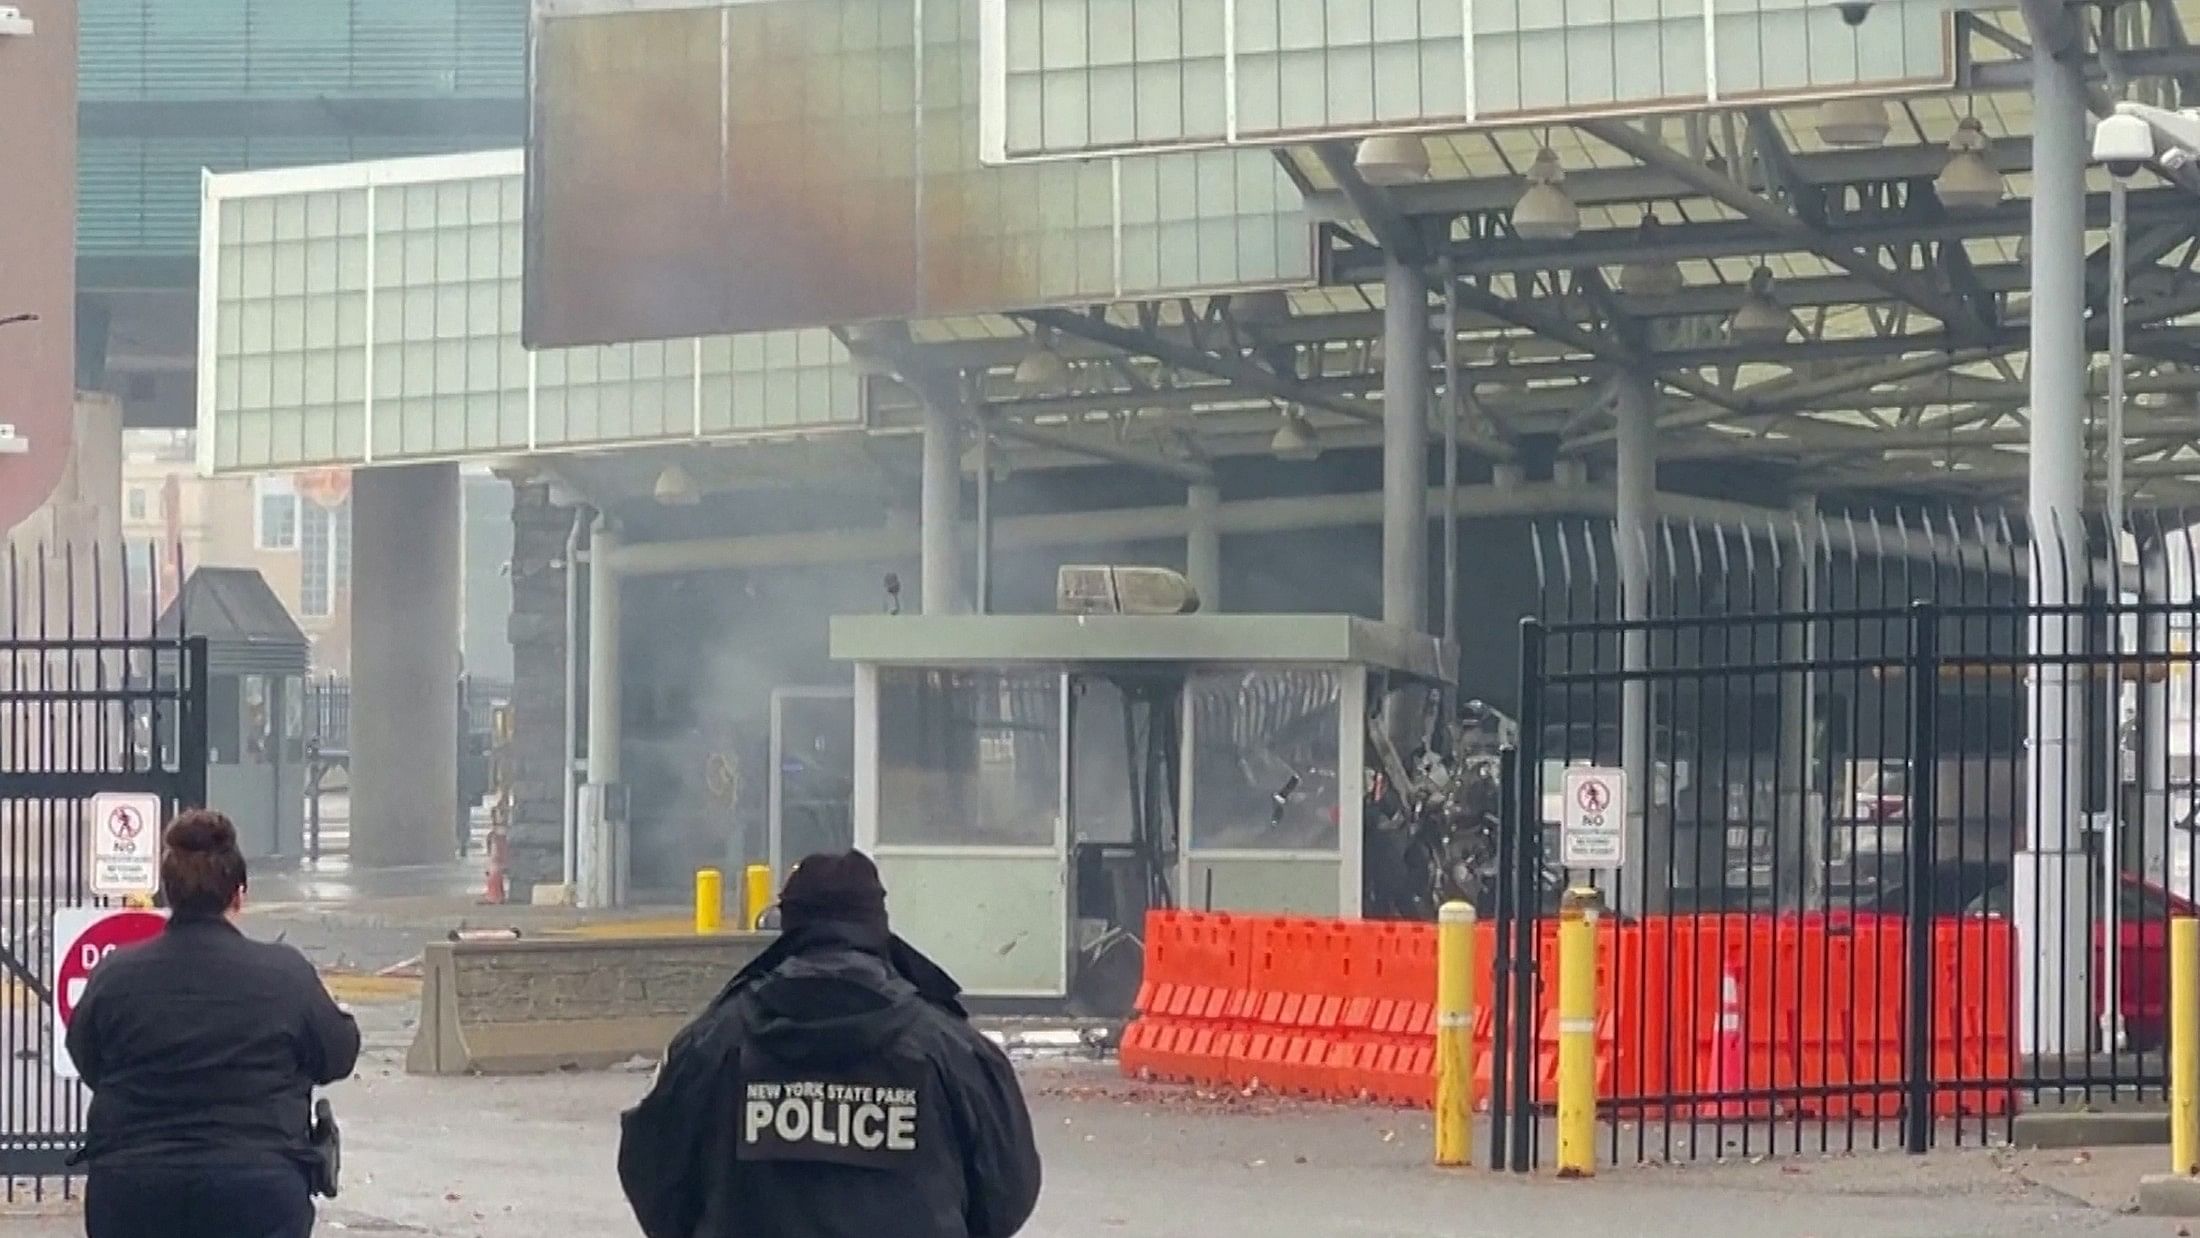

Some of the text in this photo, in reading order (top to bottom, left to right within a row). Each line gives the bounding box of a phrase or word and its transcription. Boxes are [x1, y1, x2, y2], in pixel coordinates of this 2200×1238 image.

[1582, 815, 1604, 827] NO
[113, 840, 136, 854] NO
[747, 1081, 917, 1105] NEW YORK STATE PARK
[745, 1097, 917, 1150] POLICE
